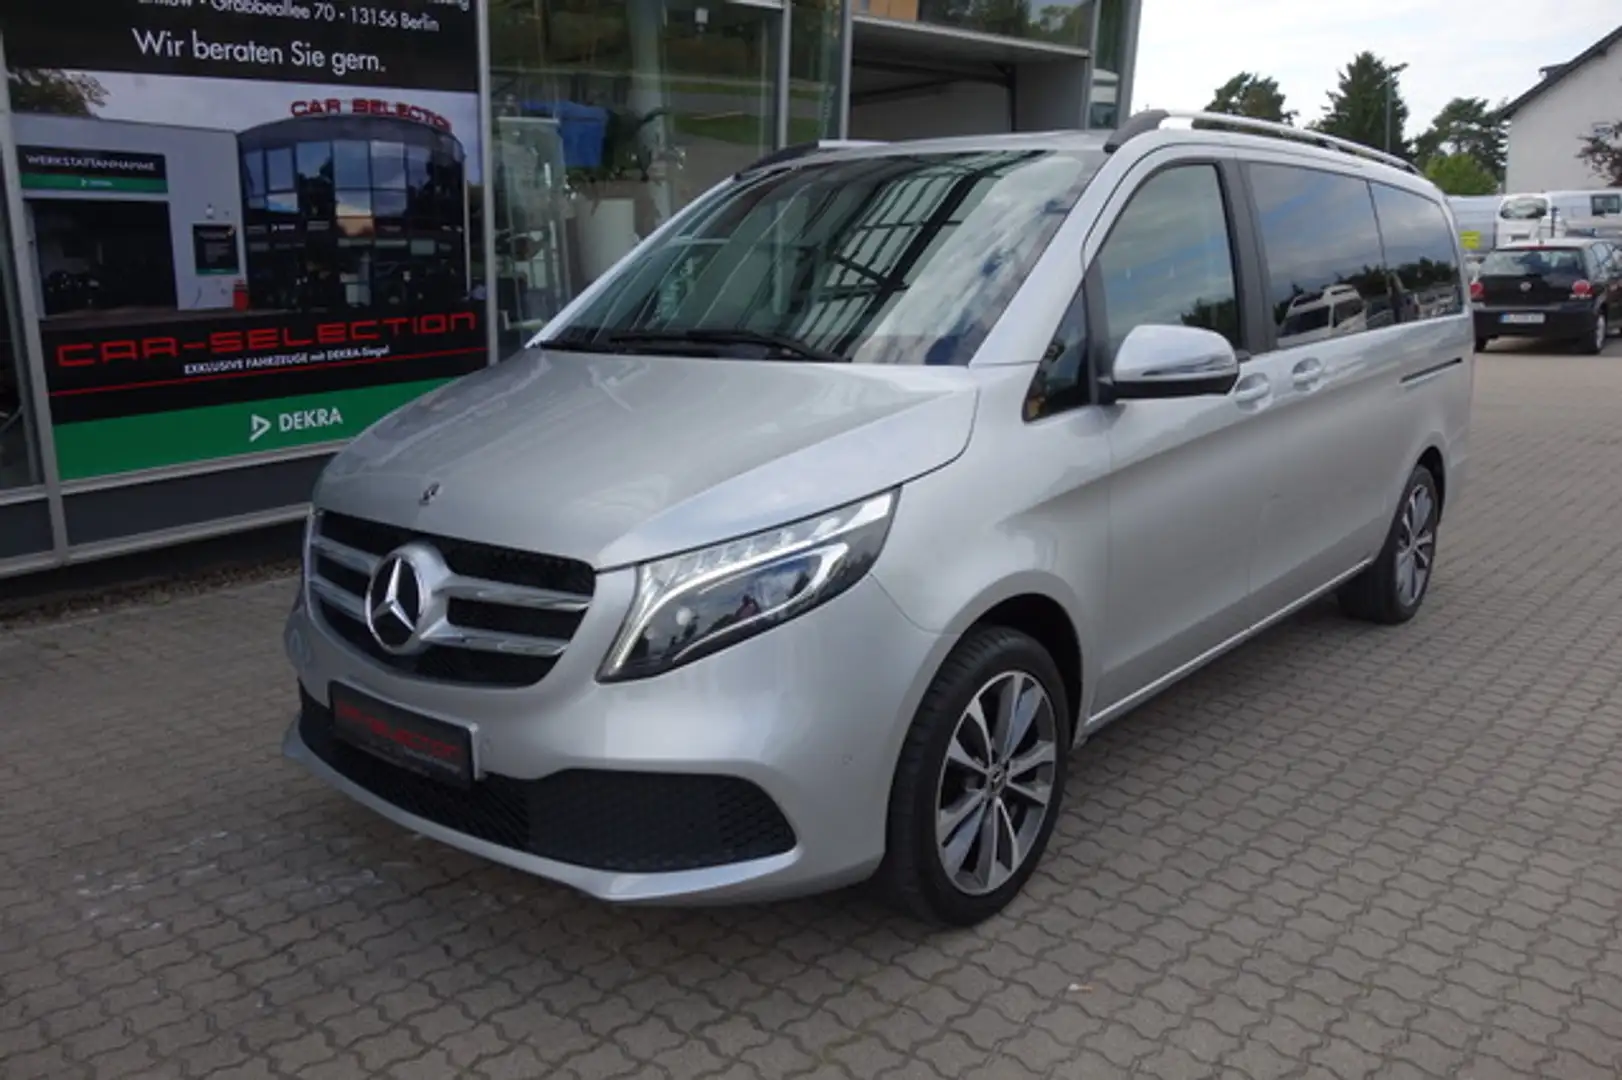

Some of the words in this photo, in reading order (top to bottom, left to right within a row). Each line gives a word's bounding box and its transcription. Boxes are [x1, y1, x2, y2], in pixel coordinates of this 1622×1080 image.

[313, 2, 336, 21] 70
[351, 7, 398, 27] 13156
[400, 12, 440, 32] Berlin
[131, 27, 184, 57] Wir
[191, 29, 283, 64] beraten
[291, 40, 325, 67] Sie
[331, 51, 386, 76] gern.
[290, 98, 341, 117] CAR
[279, 406, 343, 432] DEKRA
